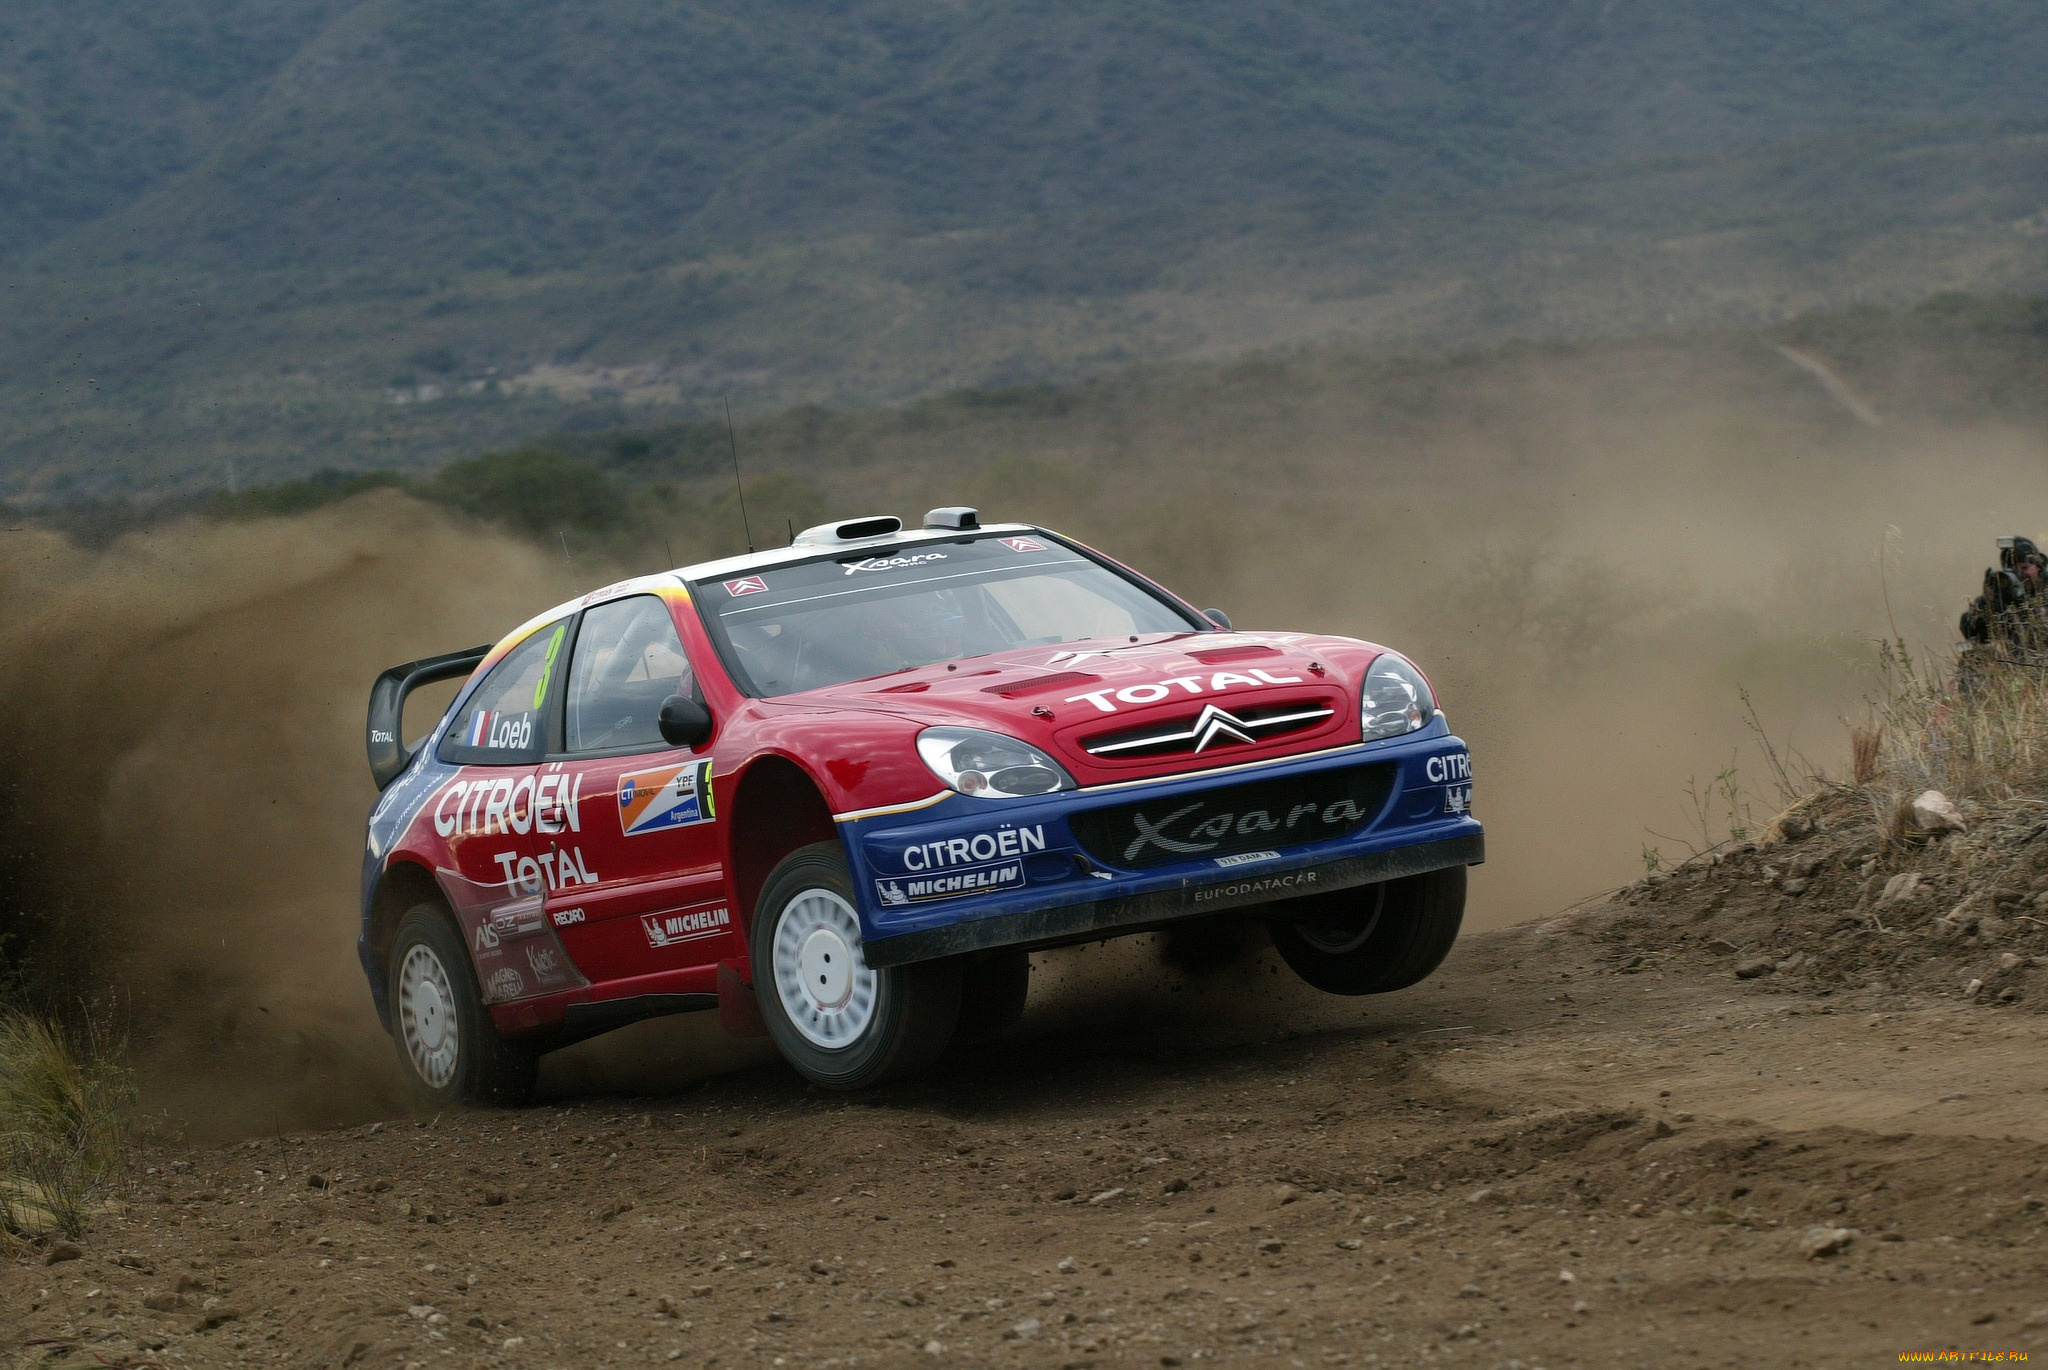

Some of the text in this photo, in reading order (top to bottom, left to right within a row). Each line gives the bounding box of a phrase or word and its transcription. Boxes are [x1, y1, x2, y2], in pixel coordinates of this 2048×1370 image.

[841, 552, 948, 575] Xsara
[533, 625, 565, 710] 3
[1065, 668, 1303, 712] TOTAL
[371, 730, 394, 743] TOTAL
[489, 711, 531, 749] Loeb
[676, 775, 694, 787] YPF
[434, 762, 583, 837] CITROËN
[670, 807, 699, 823] Argentina
[1123, 799, 1366, 861] Xsara
[903, 823, 1046, 871] CITROËN
[493, 846, 599, 898] TOTAL
[908, 866, 1018, 896] MICHELIN
[1194, 871, 1318, 902] EURODATACAR
[553, 908, 586, 926] RECARO
[666, 908, 730, 935] MICHELIN
